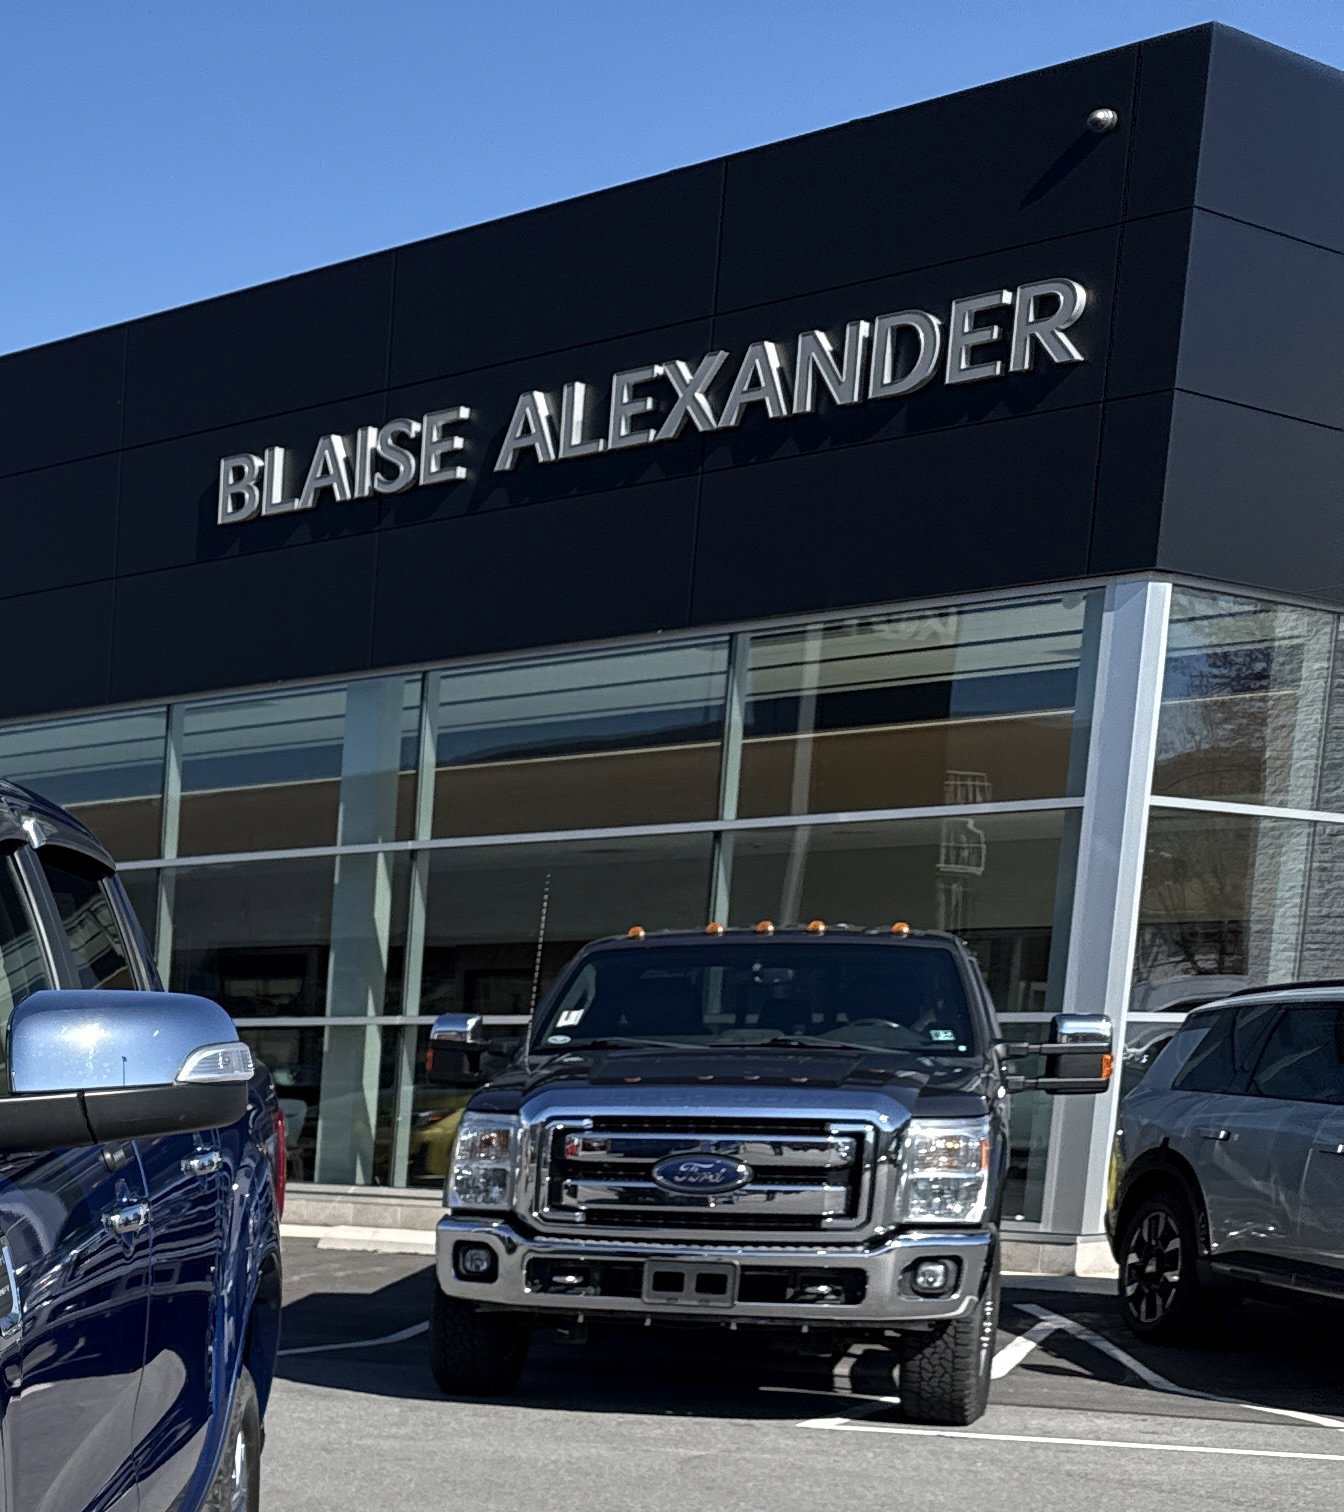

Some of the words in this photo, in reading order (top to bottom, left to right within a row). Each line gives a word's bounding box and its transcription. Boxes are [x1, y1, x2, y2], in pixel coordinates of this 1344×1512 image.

[217, 405, 469, 526] BLAISE
[494, 276, 1089, 472] ALEXANDER
[673, 1161, 727, 1183] Ford
